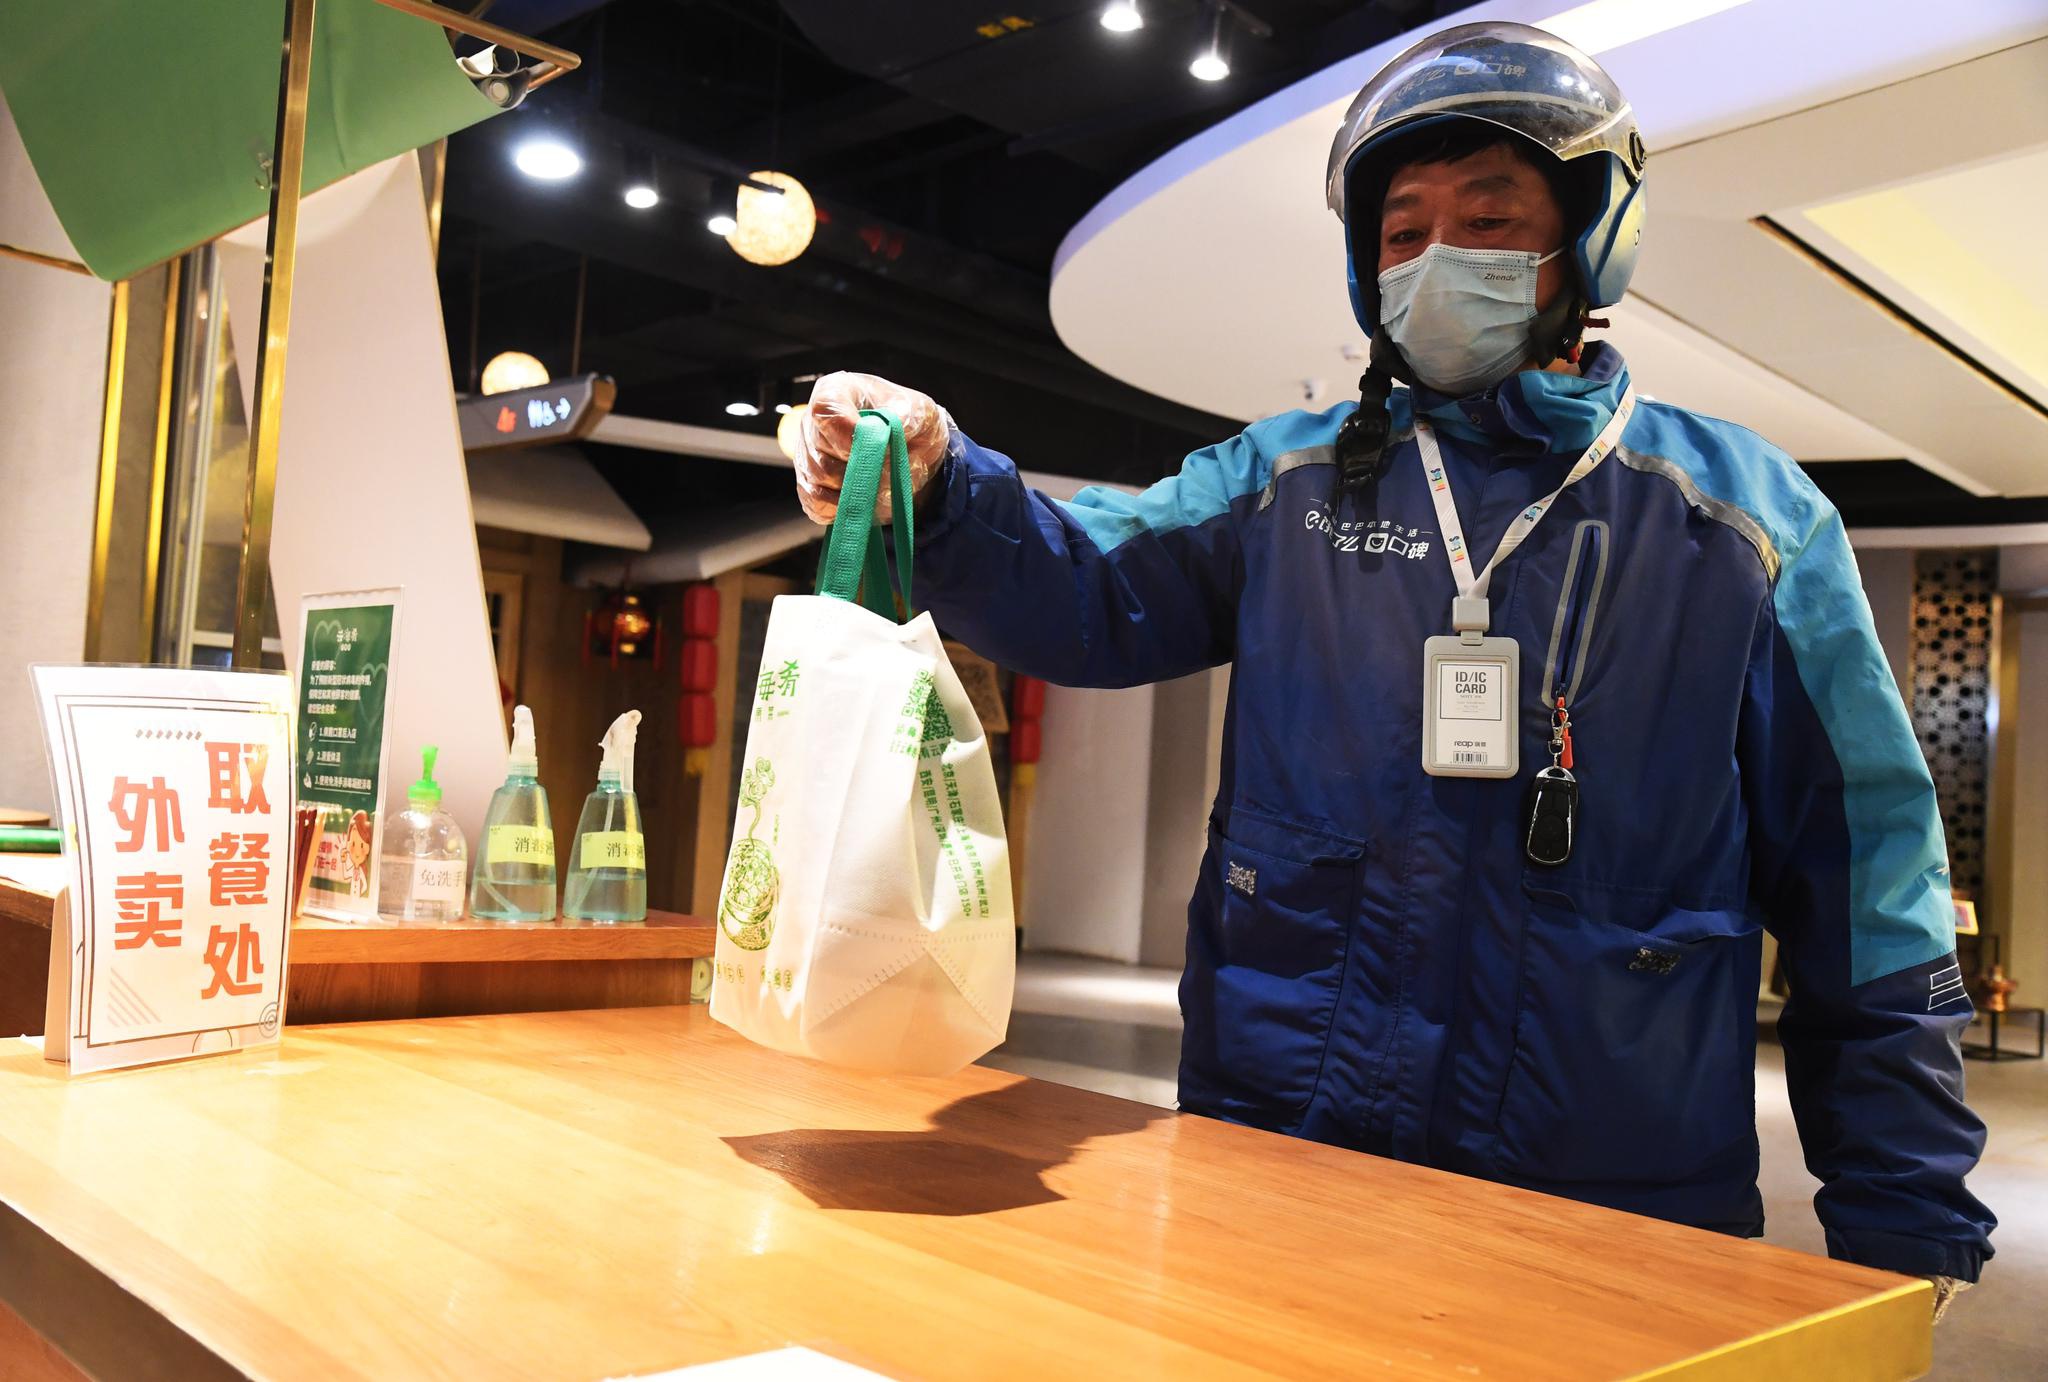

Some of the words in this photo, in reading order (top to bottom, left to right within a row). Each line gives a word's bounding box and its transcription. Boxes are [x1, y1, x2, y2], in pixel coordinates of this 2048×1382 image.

[1484, 273, 1517, 281] Zhende
[1324, 502, 1419, 538] 巴巴本地生活
[1387, 535, 1430, 560] 口碑
[1455, 671, 1487, 683] ID/IC
[1455, 683, 1487, 694] CARD
[108, 776, 185, 950] 外卖
[201, 741, 271, 1000] 取餐处
[419, 868, 466, 887] 免洗手
